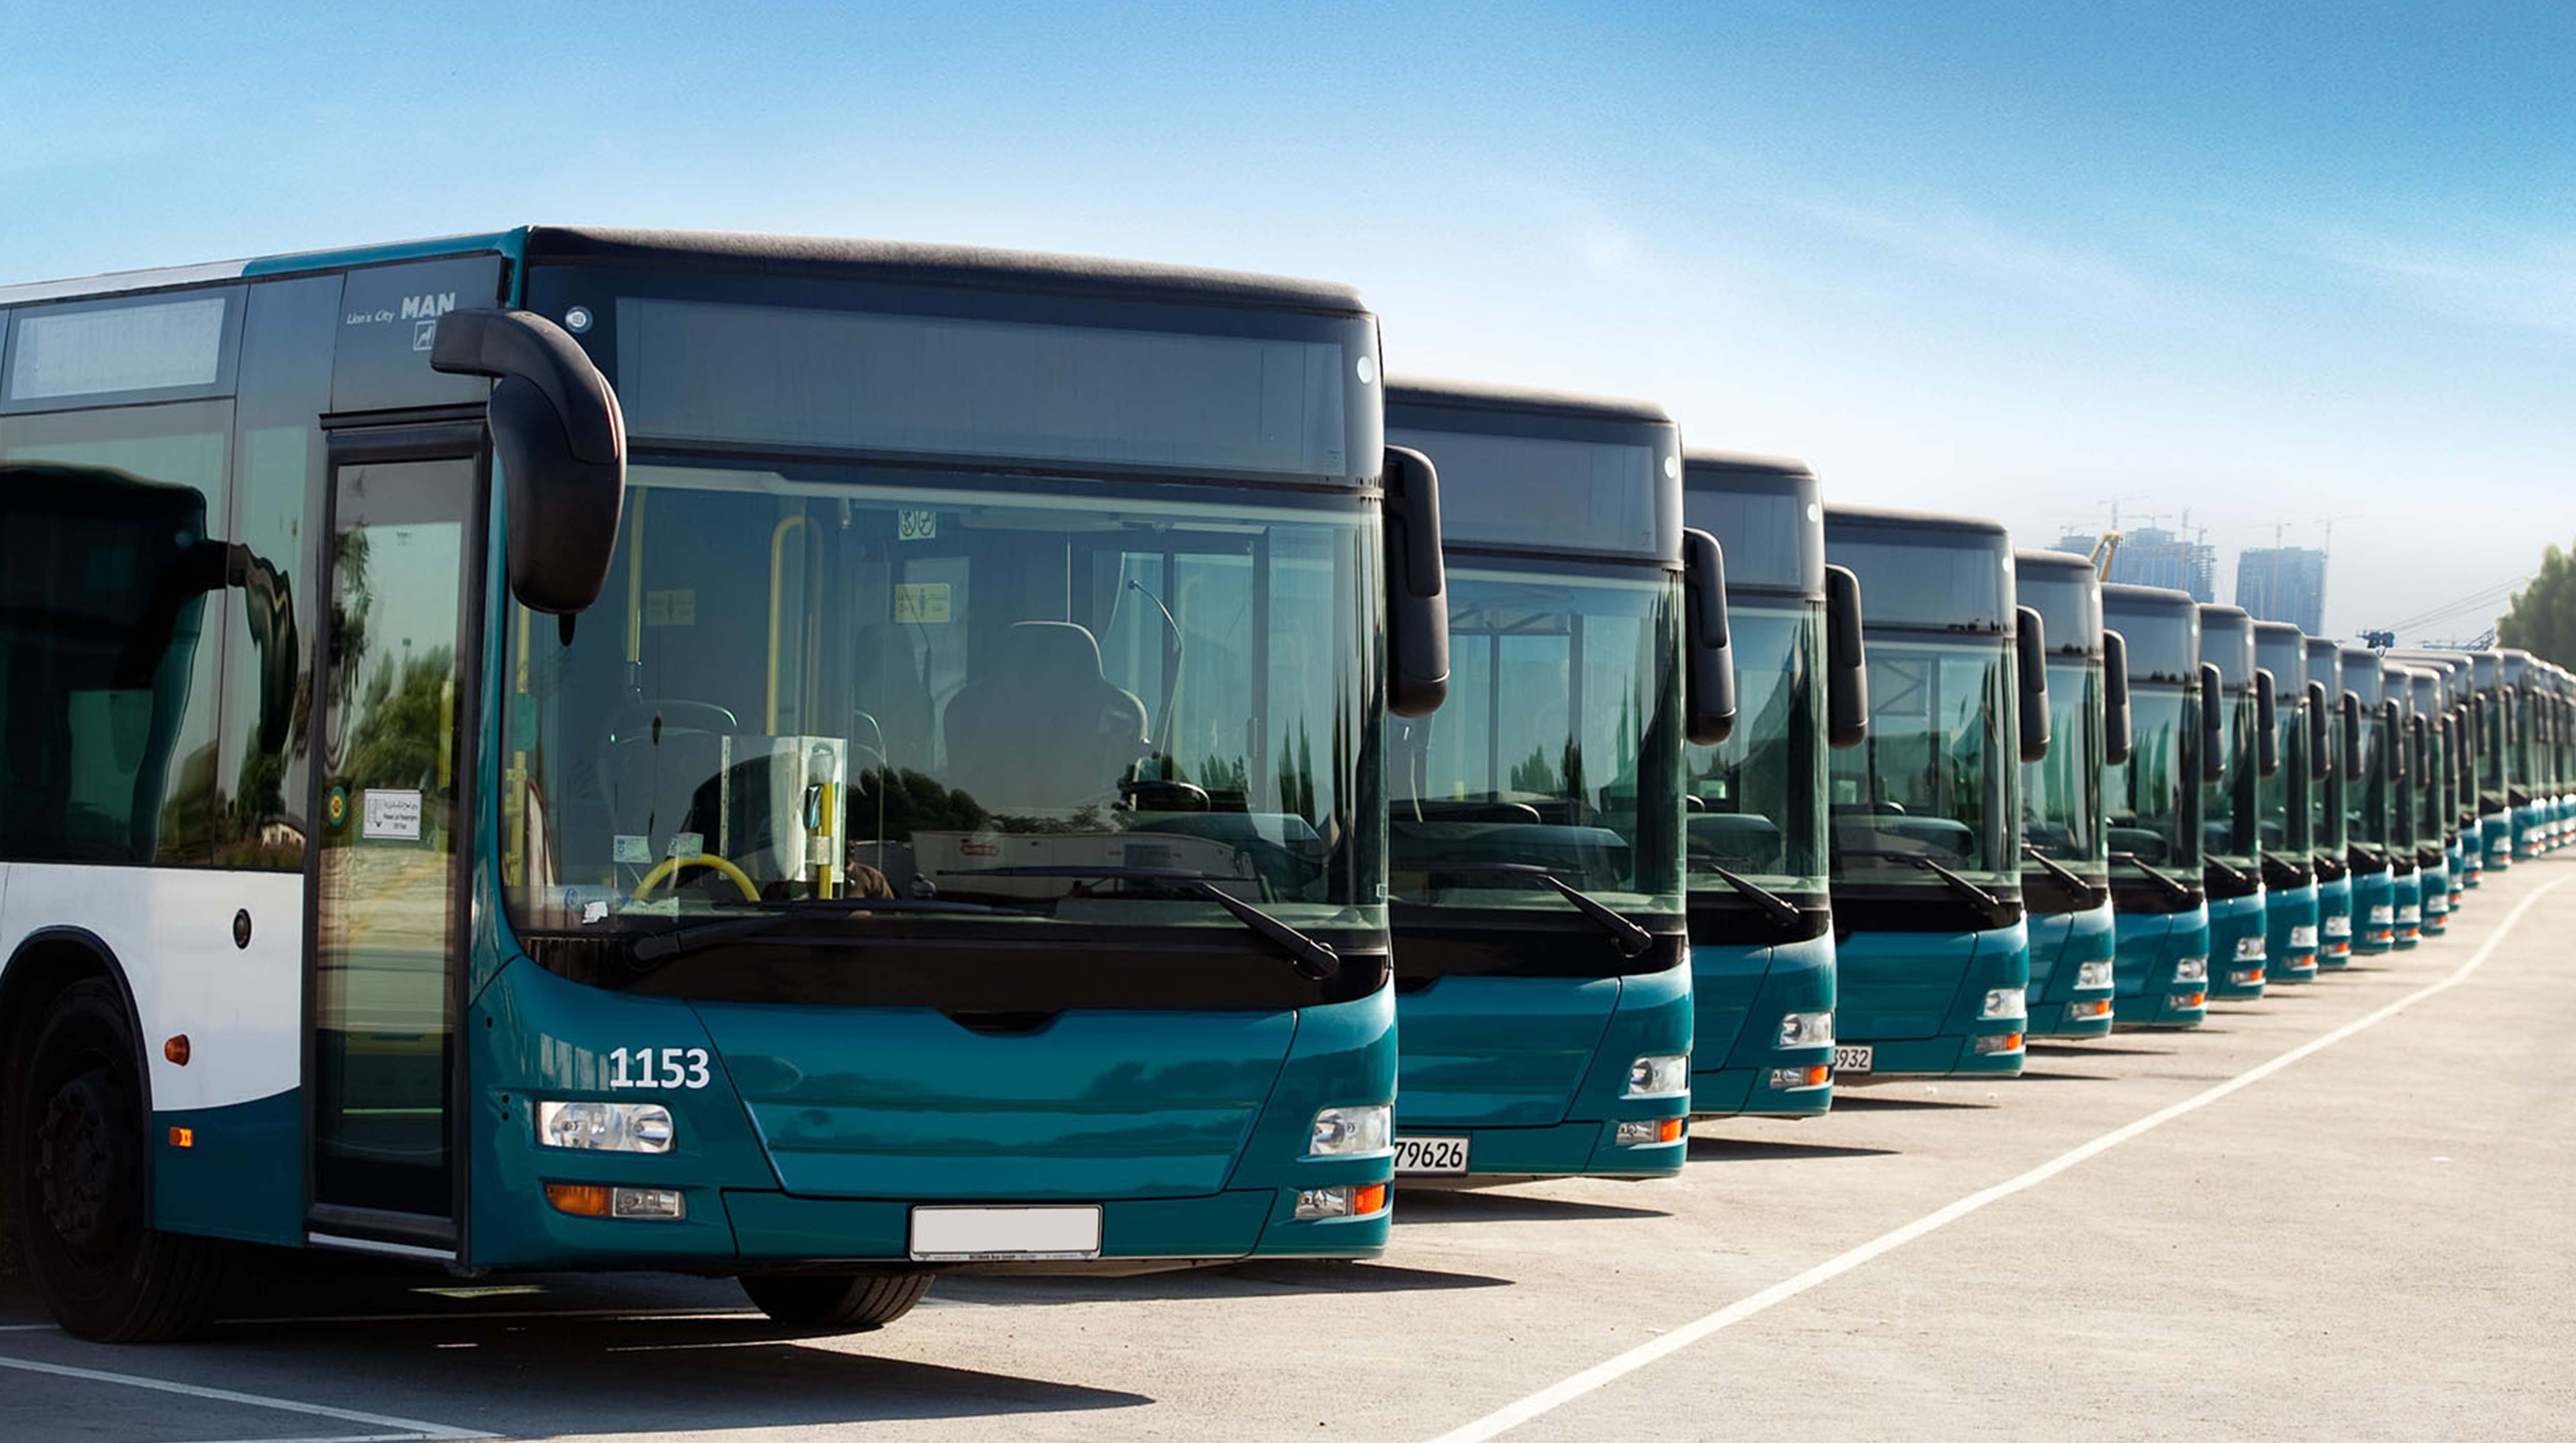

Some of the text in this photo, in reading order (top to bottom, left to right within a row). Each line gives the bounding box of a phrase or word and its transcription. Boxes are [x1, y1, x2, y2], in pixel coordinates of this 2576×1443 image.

[375, 309, 395, 324] City
[401, 292, 456, 320] MAN
[609, 1047, 710, 1089] 1153
[1394, 1141, 1463, 1168] 79626
